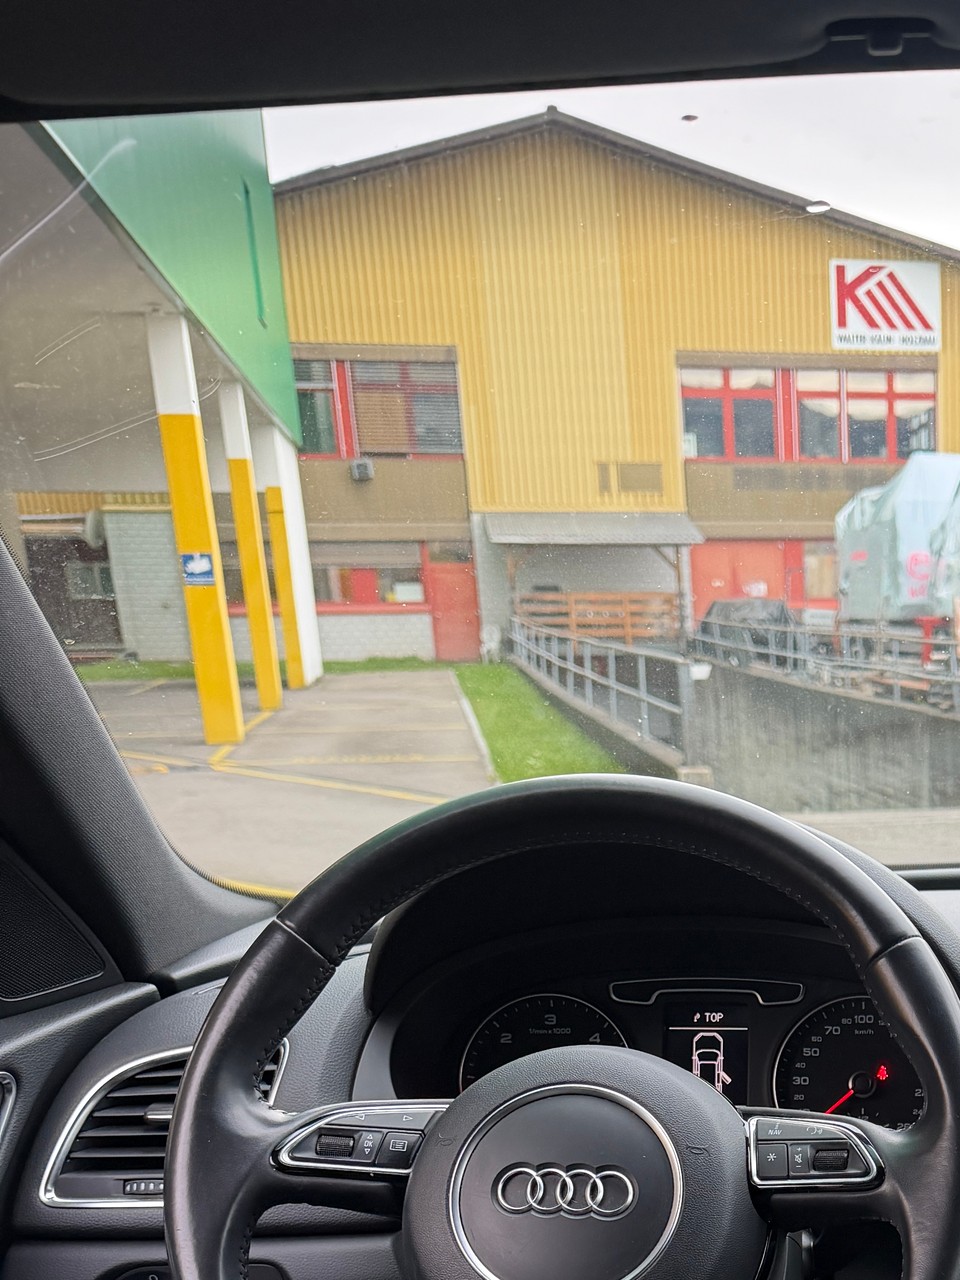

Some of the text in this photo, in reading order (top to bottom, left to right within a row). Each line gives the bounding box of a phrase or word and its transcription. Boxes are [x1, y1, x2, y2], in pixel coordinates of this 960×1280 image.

[544, 1014, 557, 1025] 3
[704, 1012, 724, 1023] TOP
[854, 1014, 874, 1024] 100
[824, 1026, 841, 1035] 70
[500, 1033, 512, 1044] 2
[588, 1032, 601, 1043] 4
[803, 1047, 820, 1057] 50
[792, 1076, 809, 1085] 30
[767, 1128, 782, 1136] NAV
[363, 1140, 374, 1148] OK
